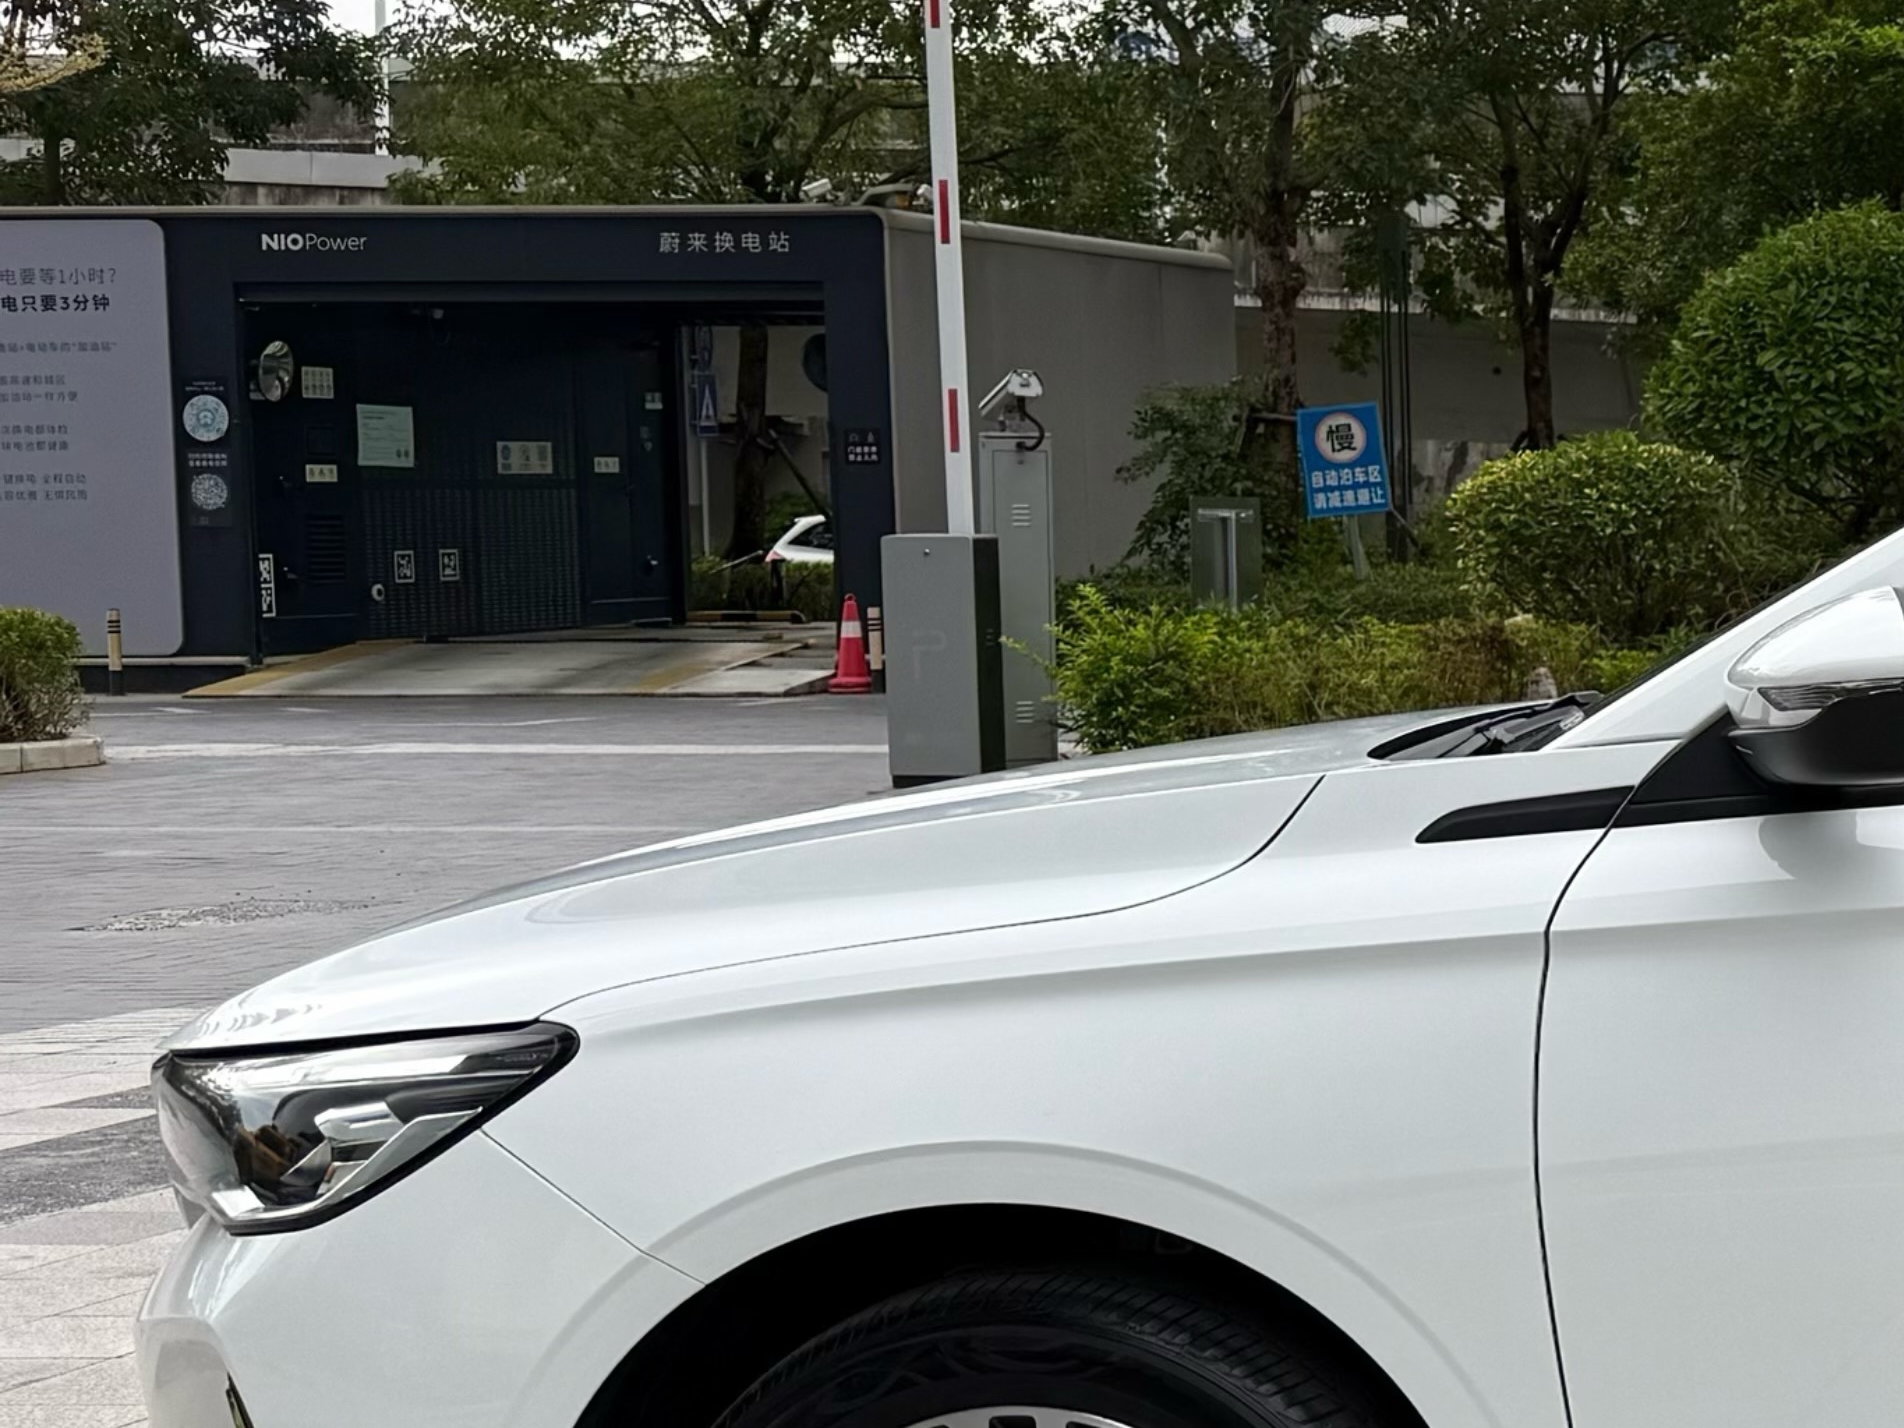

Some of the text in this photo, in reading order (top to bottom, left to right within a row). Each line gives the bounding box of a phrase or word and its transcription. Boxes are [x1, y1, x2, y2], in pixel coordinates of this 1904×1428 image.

[659, 231, 790, 253] 蔚来换电站
[0, 293, 110, 313] 电只要3分钟
[1326, 423, 1357, 453] 慢
[1312, 465, 1382, 488] 自动泊车区
